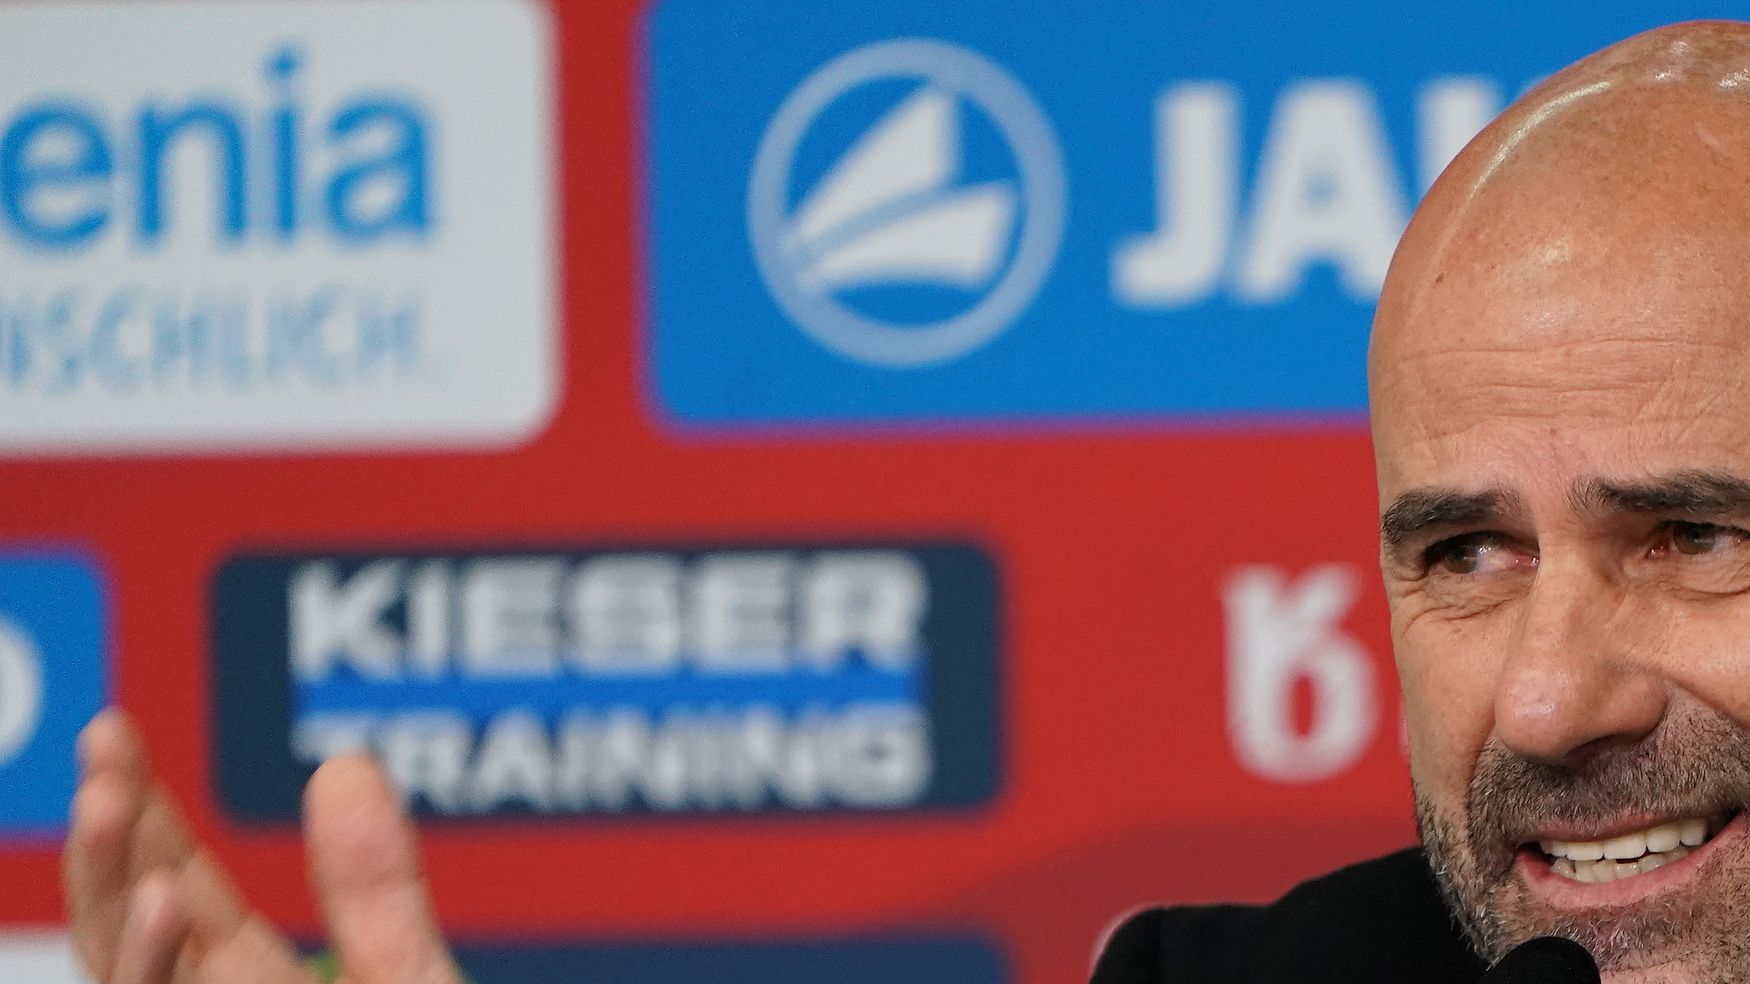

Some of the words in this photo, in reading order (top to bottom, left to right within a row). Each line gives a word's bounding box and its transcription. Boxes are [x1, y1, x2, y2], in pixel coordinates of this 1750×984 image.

[0, 48, 434, 246] enia
[1112, 78, 1535, 305] JA
[290, 553, 928, 682] KIESER
